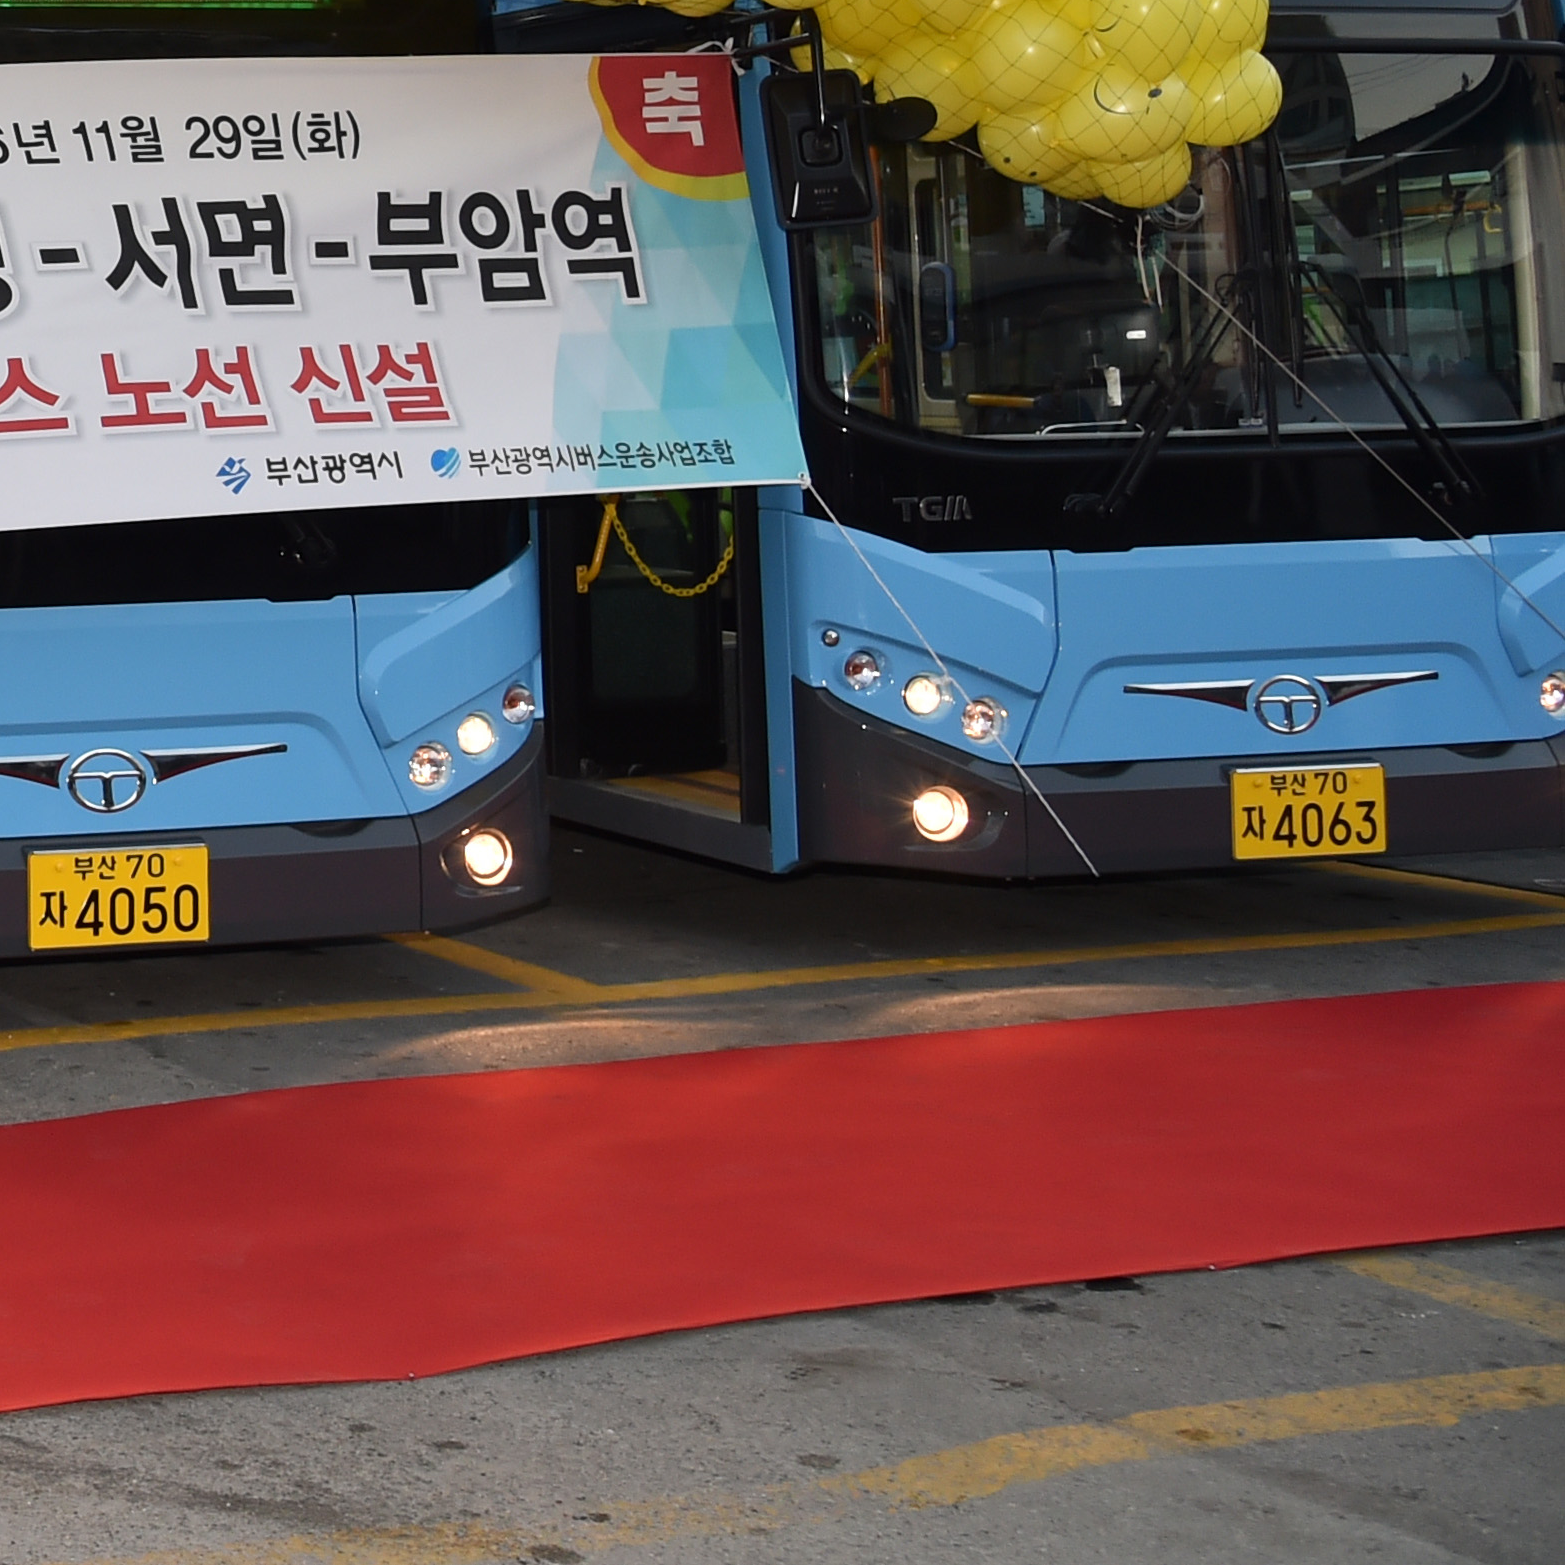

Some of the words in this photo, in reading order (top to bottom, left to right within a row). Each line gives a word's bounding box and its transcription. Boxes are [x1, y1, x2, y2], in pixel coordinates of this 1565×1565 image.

[642, 70, 705, 147] 축
[71, 114, 166, 164] 11월
[99, 345, 269, 430] 노선
[291, 341, 451, 425] 신설
[265, 450, 404, 487] 부산광역시
[467, 438, 736, 478] 부산광역시버스운송사업조합
[1269, 773, 1306, 797] 부산
[1314, 771, 1348, 795] 70
[73, 855, 116, 881] 부산
[126, 853, 165, 879] 70
